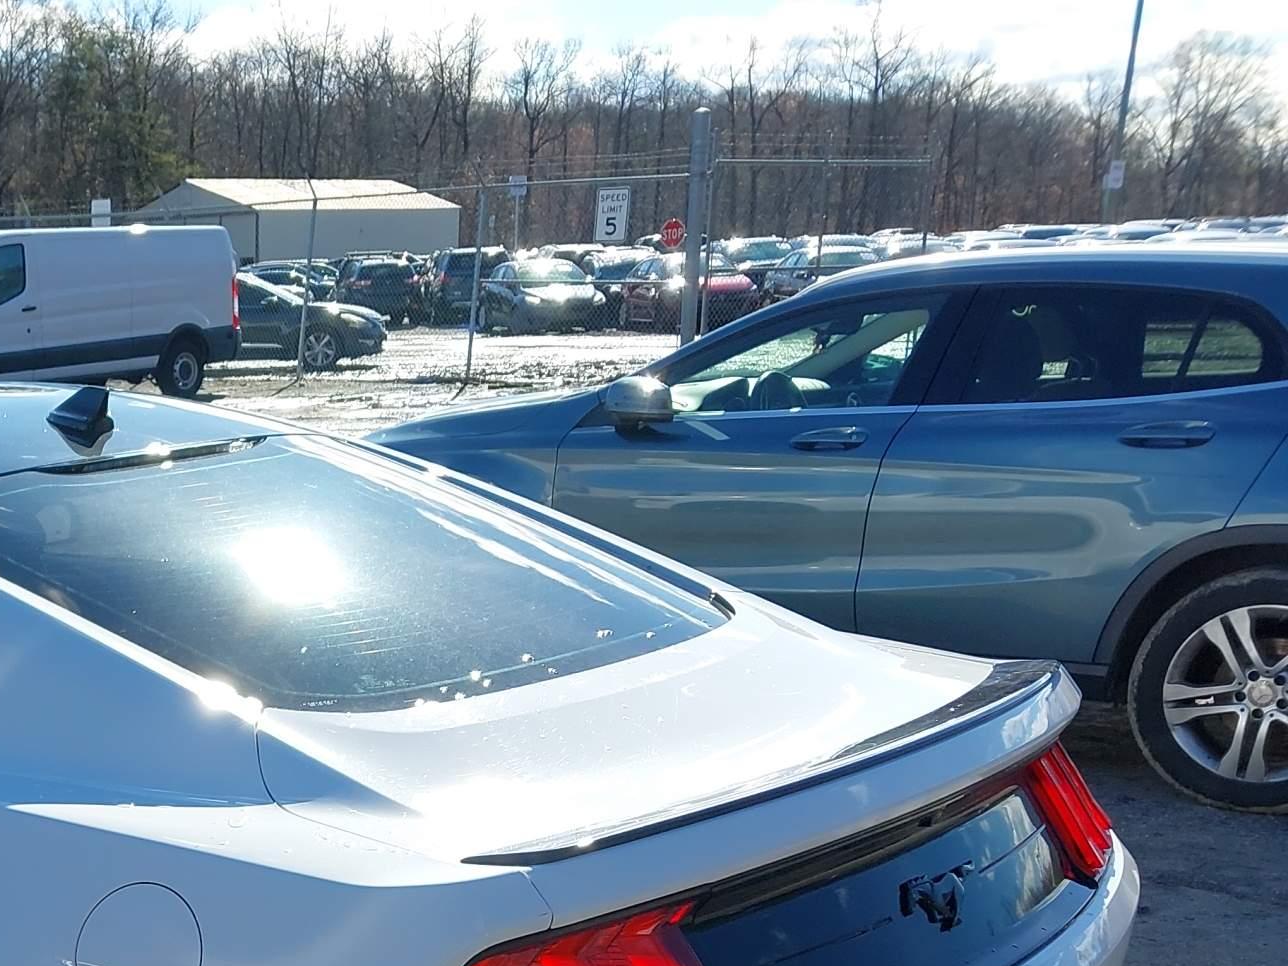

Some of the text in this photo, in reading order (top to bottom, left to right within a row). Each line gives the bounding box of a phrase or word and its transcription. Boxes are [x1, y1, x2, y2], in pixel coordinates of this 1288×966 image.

[600, 193, 627, 202] SPEED
[601, 205, 623, 214] LIMIT
[604, 216, 617, 236] 5
[662, 227, 683, 240] STOP
